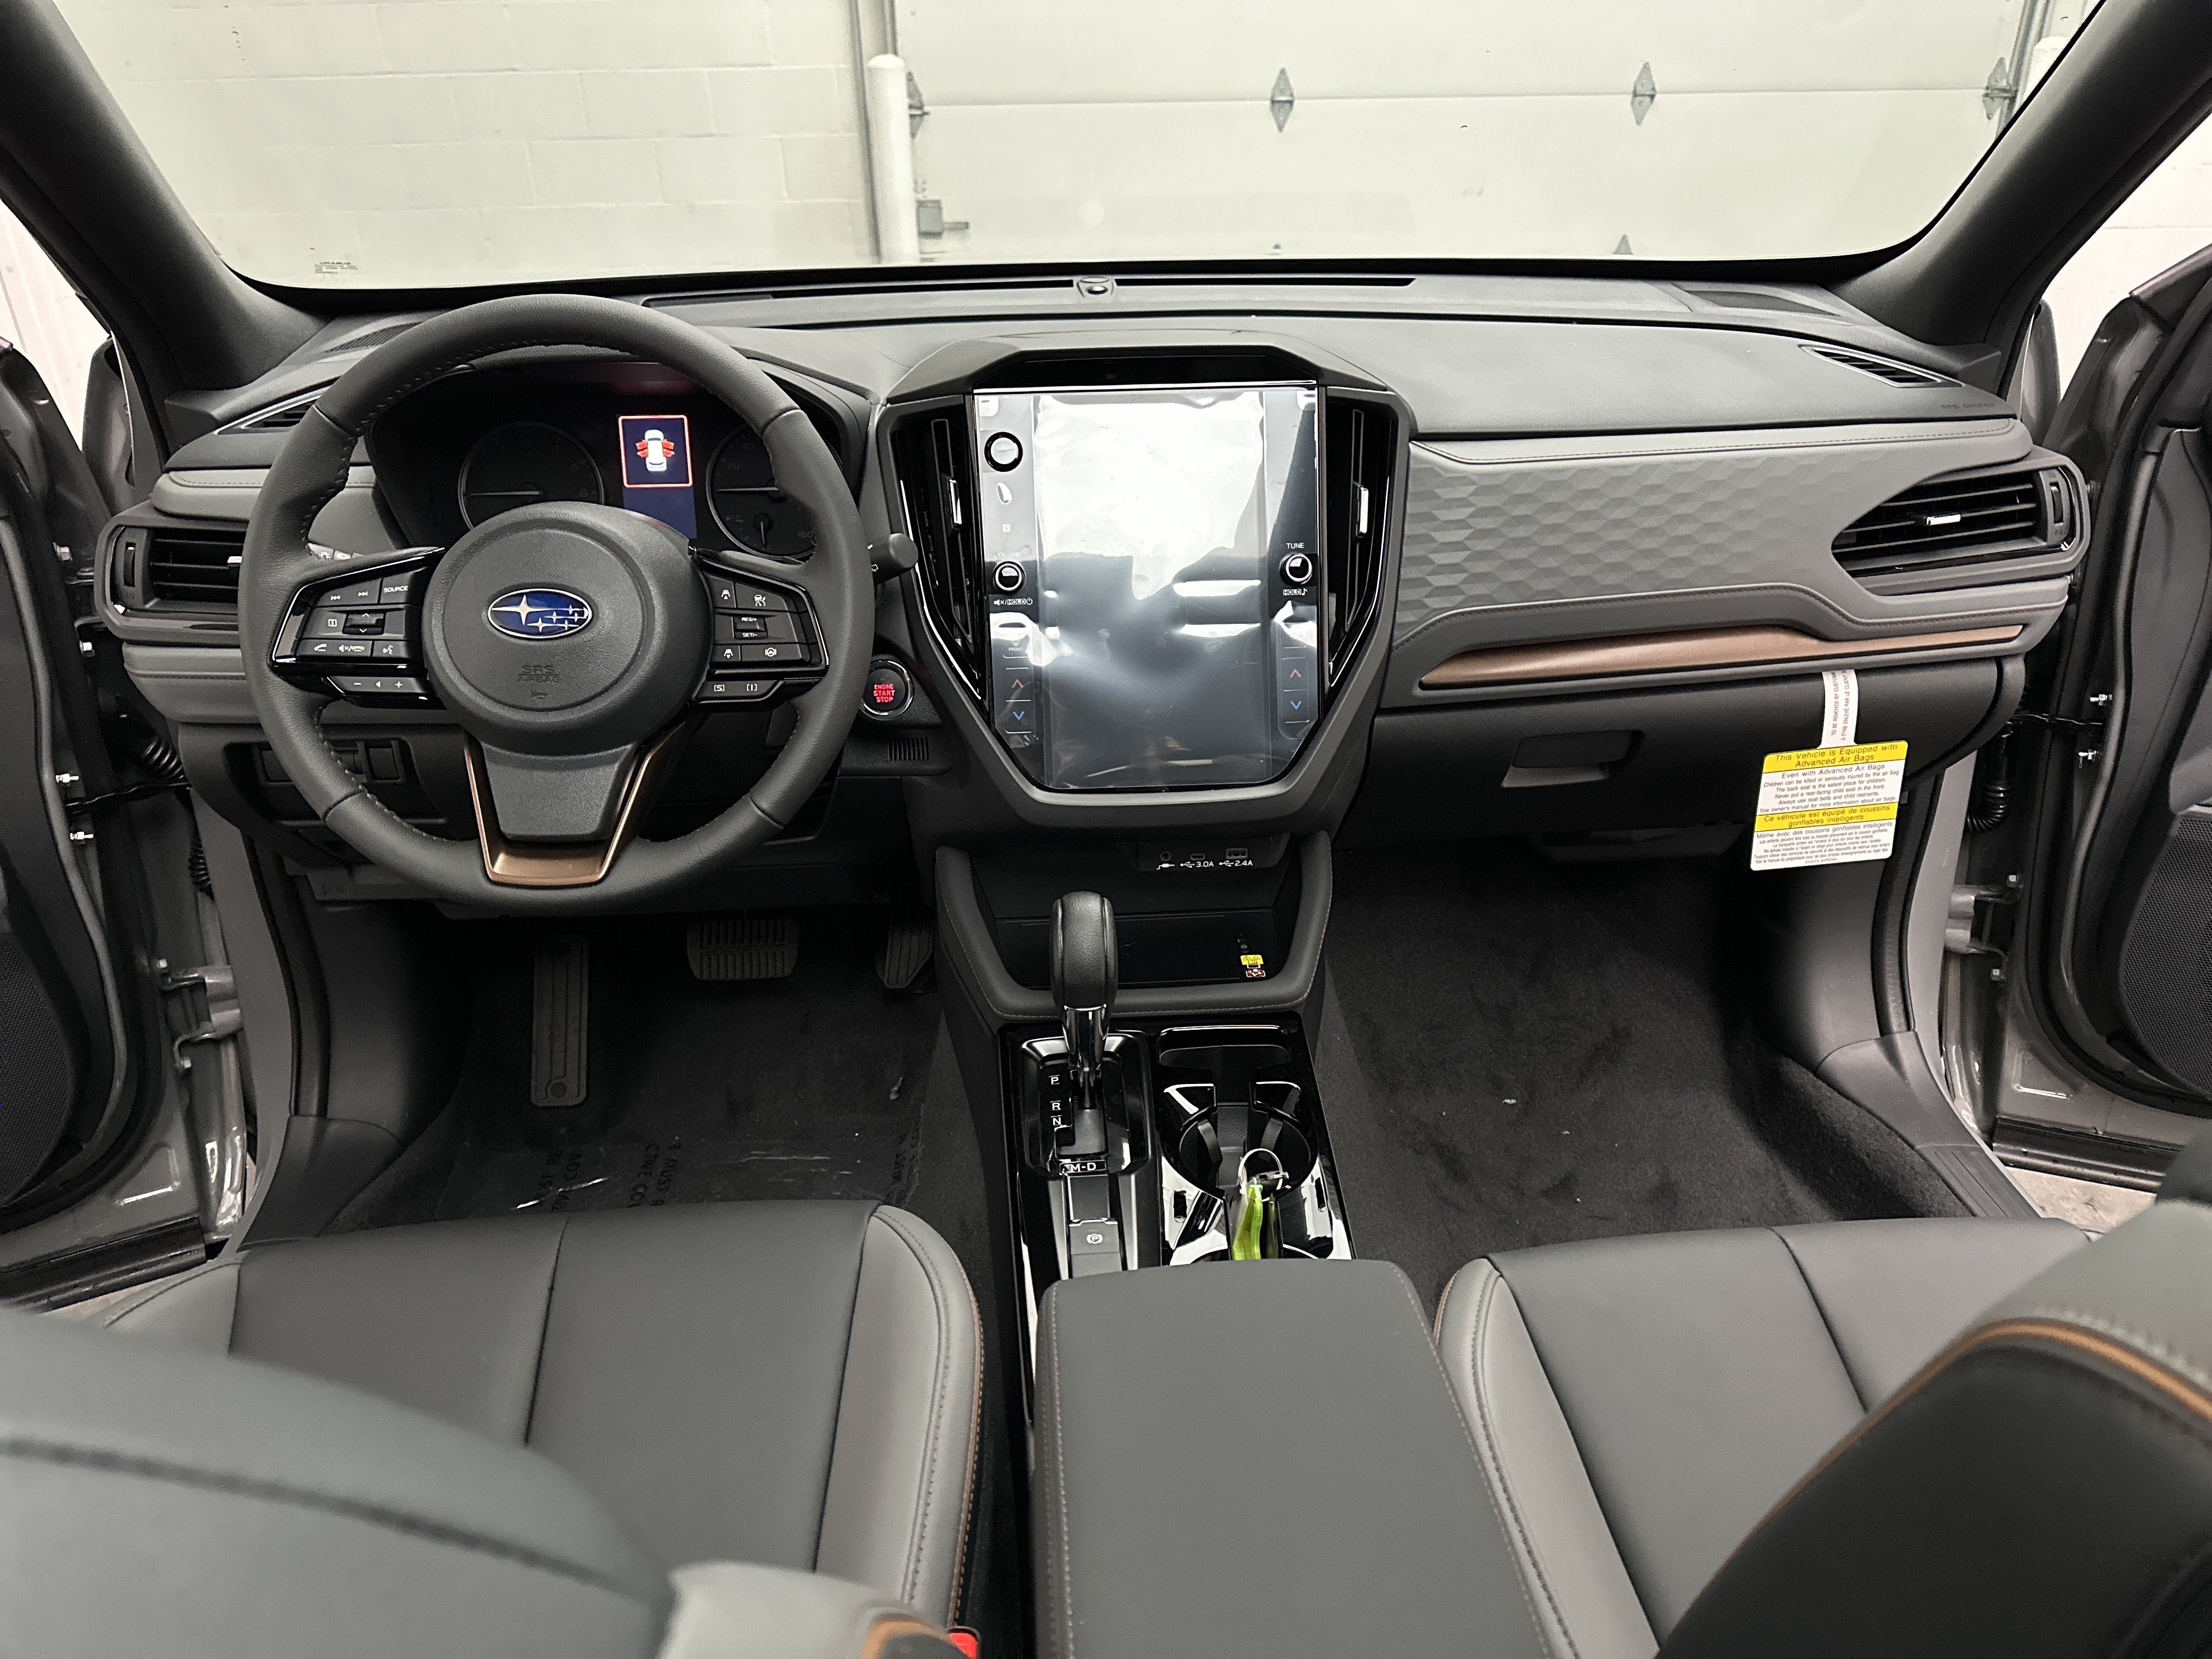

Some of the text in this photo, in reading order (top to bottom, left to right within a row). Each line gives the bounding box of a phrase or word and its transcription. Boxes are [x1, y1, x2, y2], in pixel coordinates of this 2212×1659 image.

[521, 665, 555, 674] SRS
[1796, 751, 1826, 759] Vehicle
[1839, 745, 1878, 755] Equipped
[1795, 757, 1836, 768] Advanced
[1818, 766, 1853, 775] Advanced
[1788, 814, 1864, 828] gonflables intelligents
[1832, 825, 1861, 833] gonflables
[1051, 1076, 1059, 1085] P
[1052, 1102, 1061, 1111] R
[1052, 1118, 1062, 1126] N
